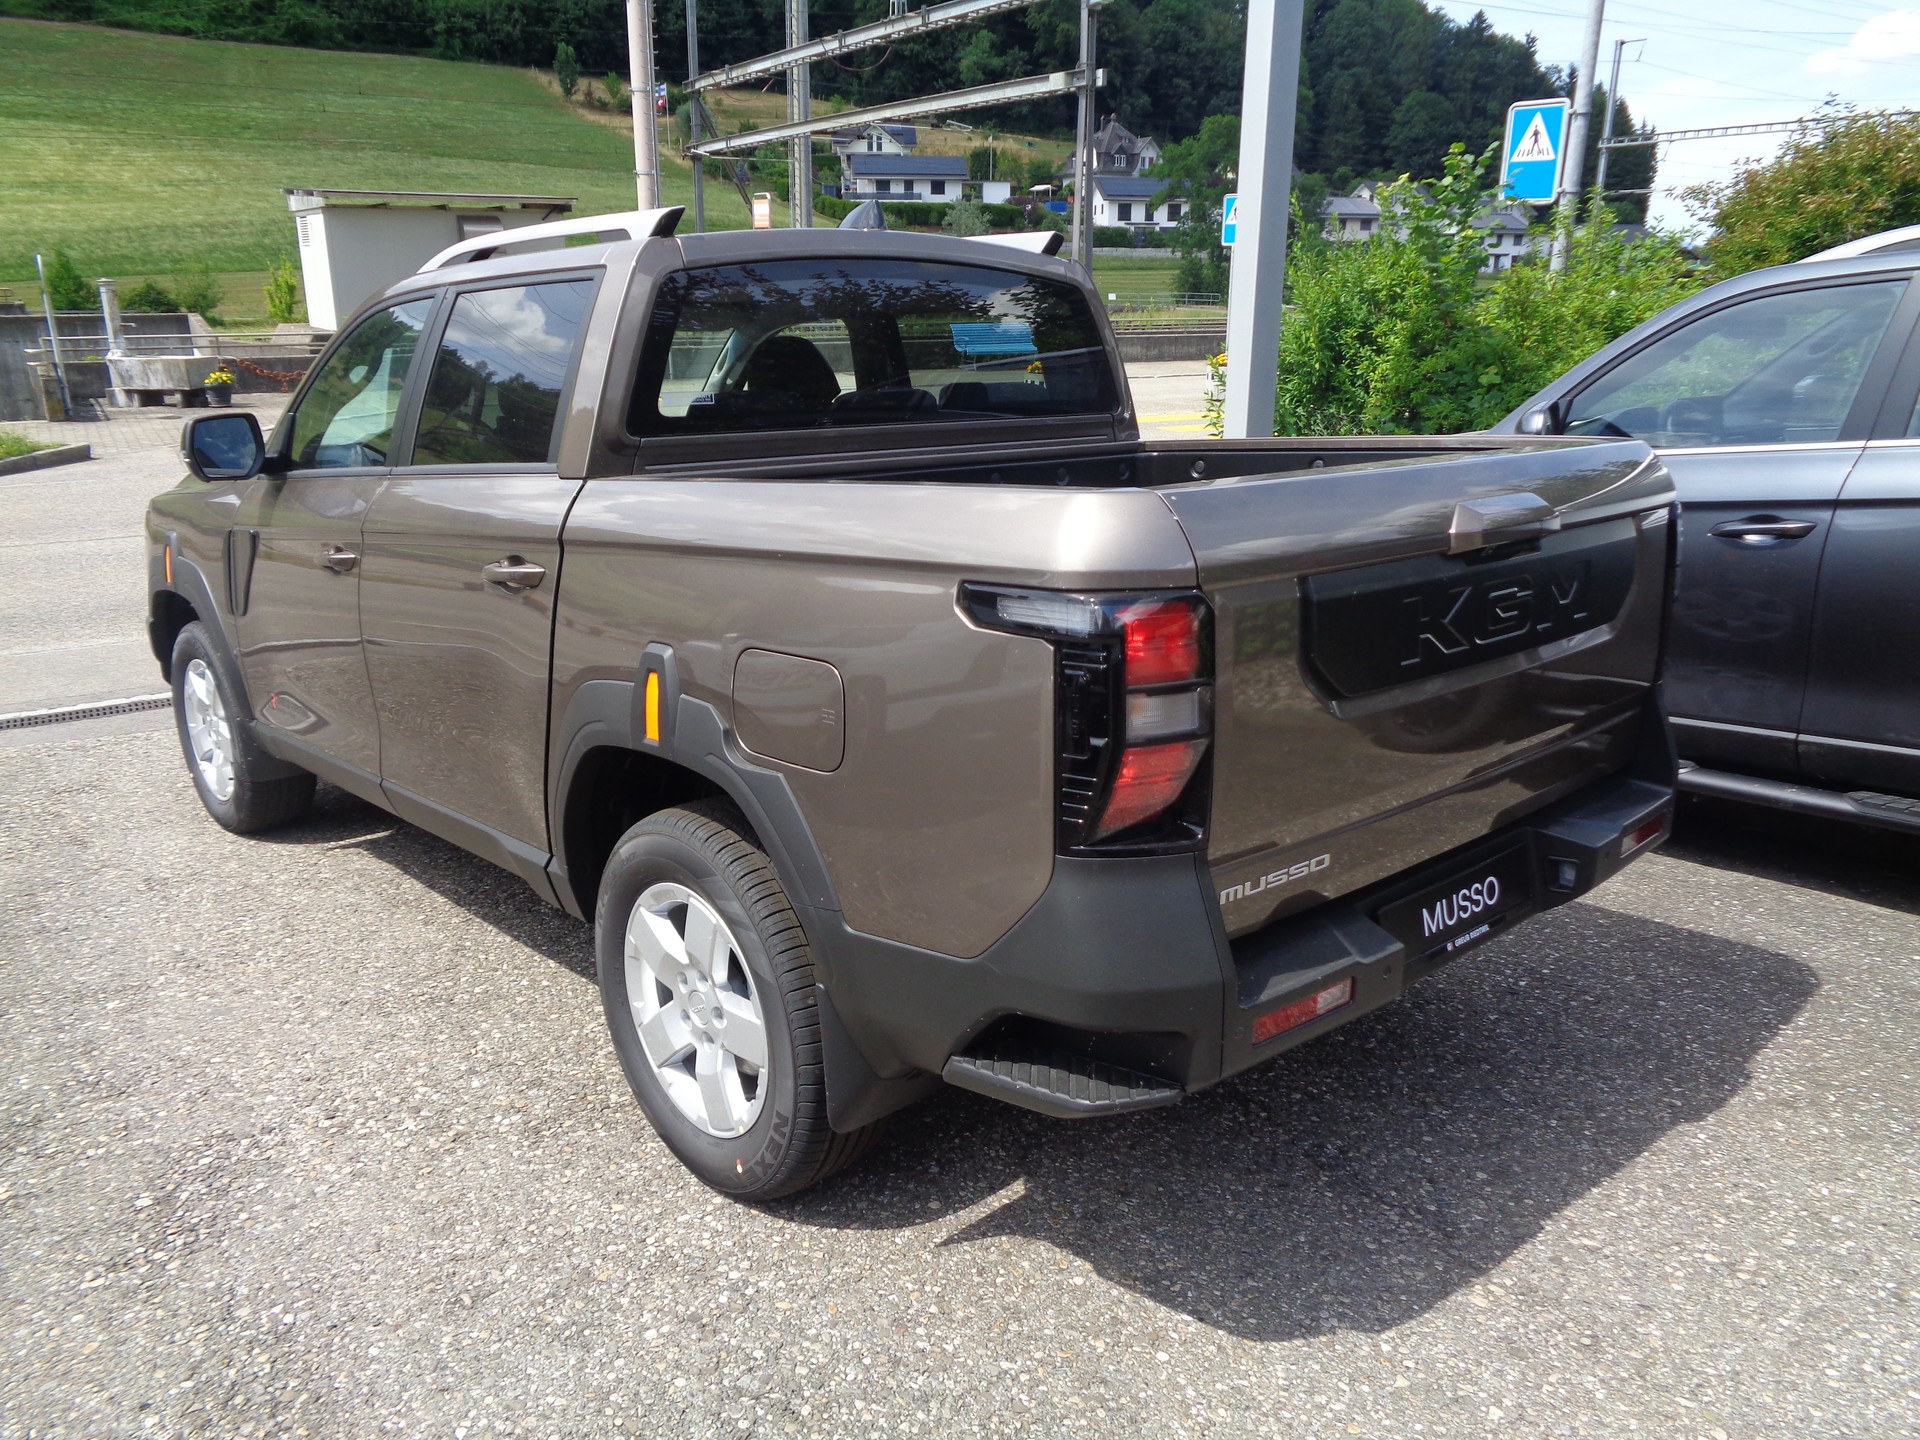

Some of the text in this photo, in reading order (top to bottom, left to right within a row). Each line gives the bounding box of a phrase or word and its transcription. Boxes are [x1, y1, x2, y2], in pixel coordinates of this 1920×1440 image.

[1400, 559, 1591, 666] KGM
[1220, 854, 1330, 904] MUSSO
[1422, 876, 1499, 936] MUSSO
[730, 1109, 790, 1187] NEXE
